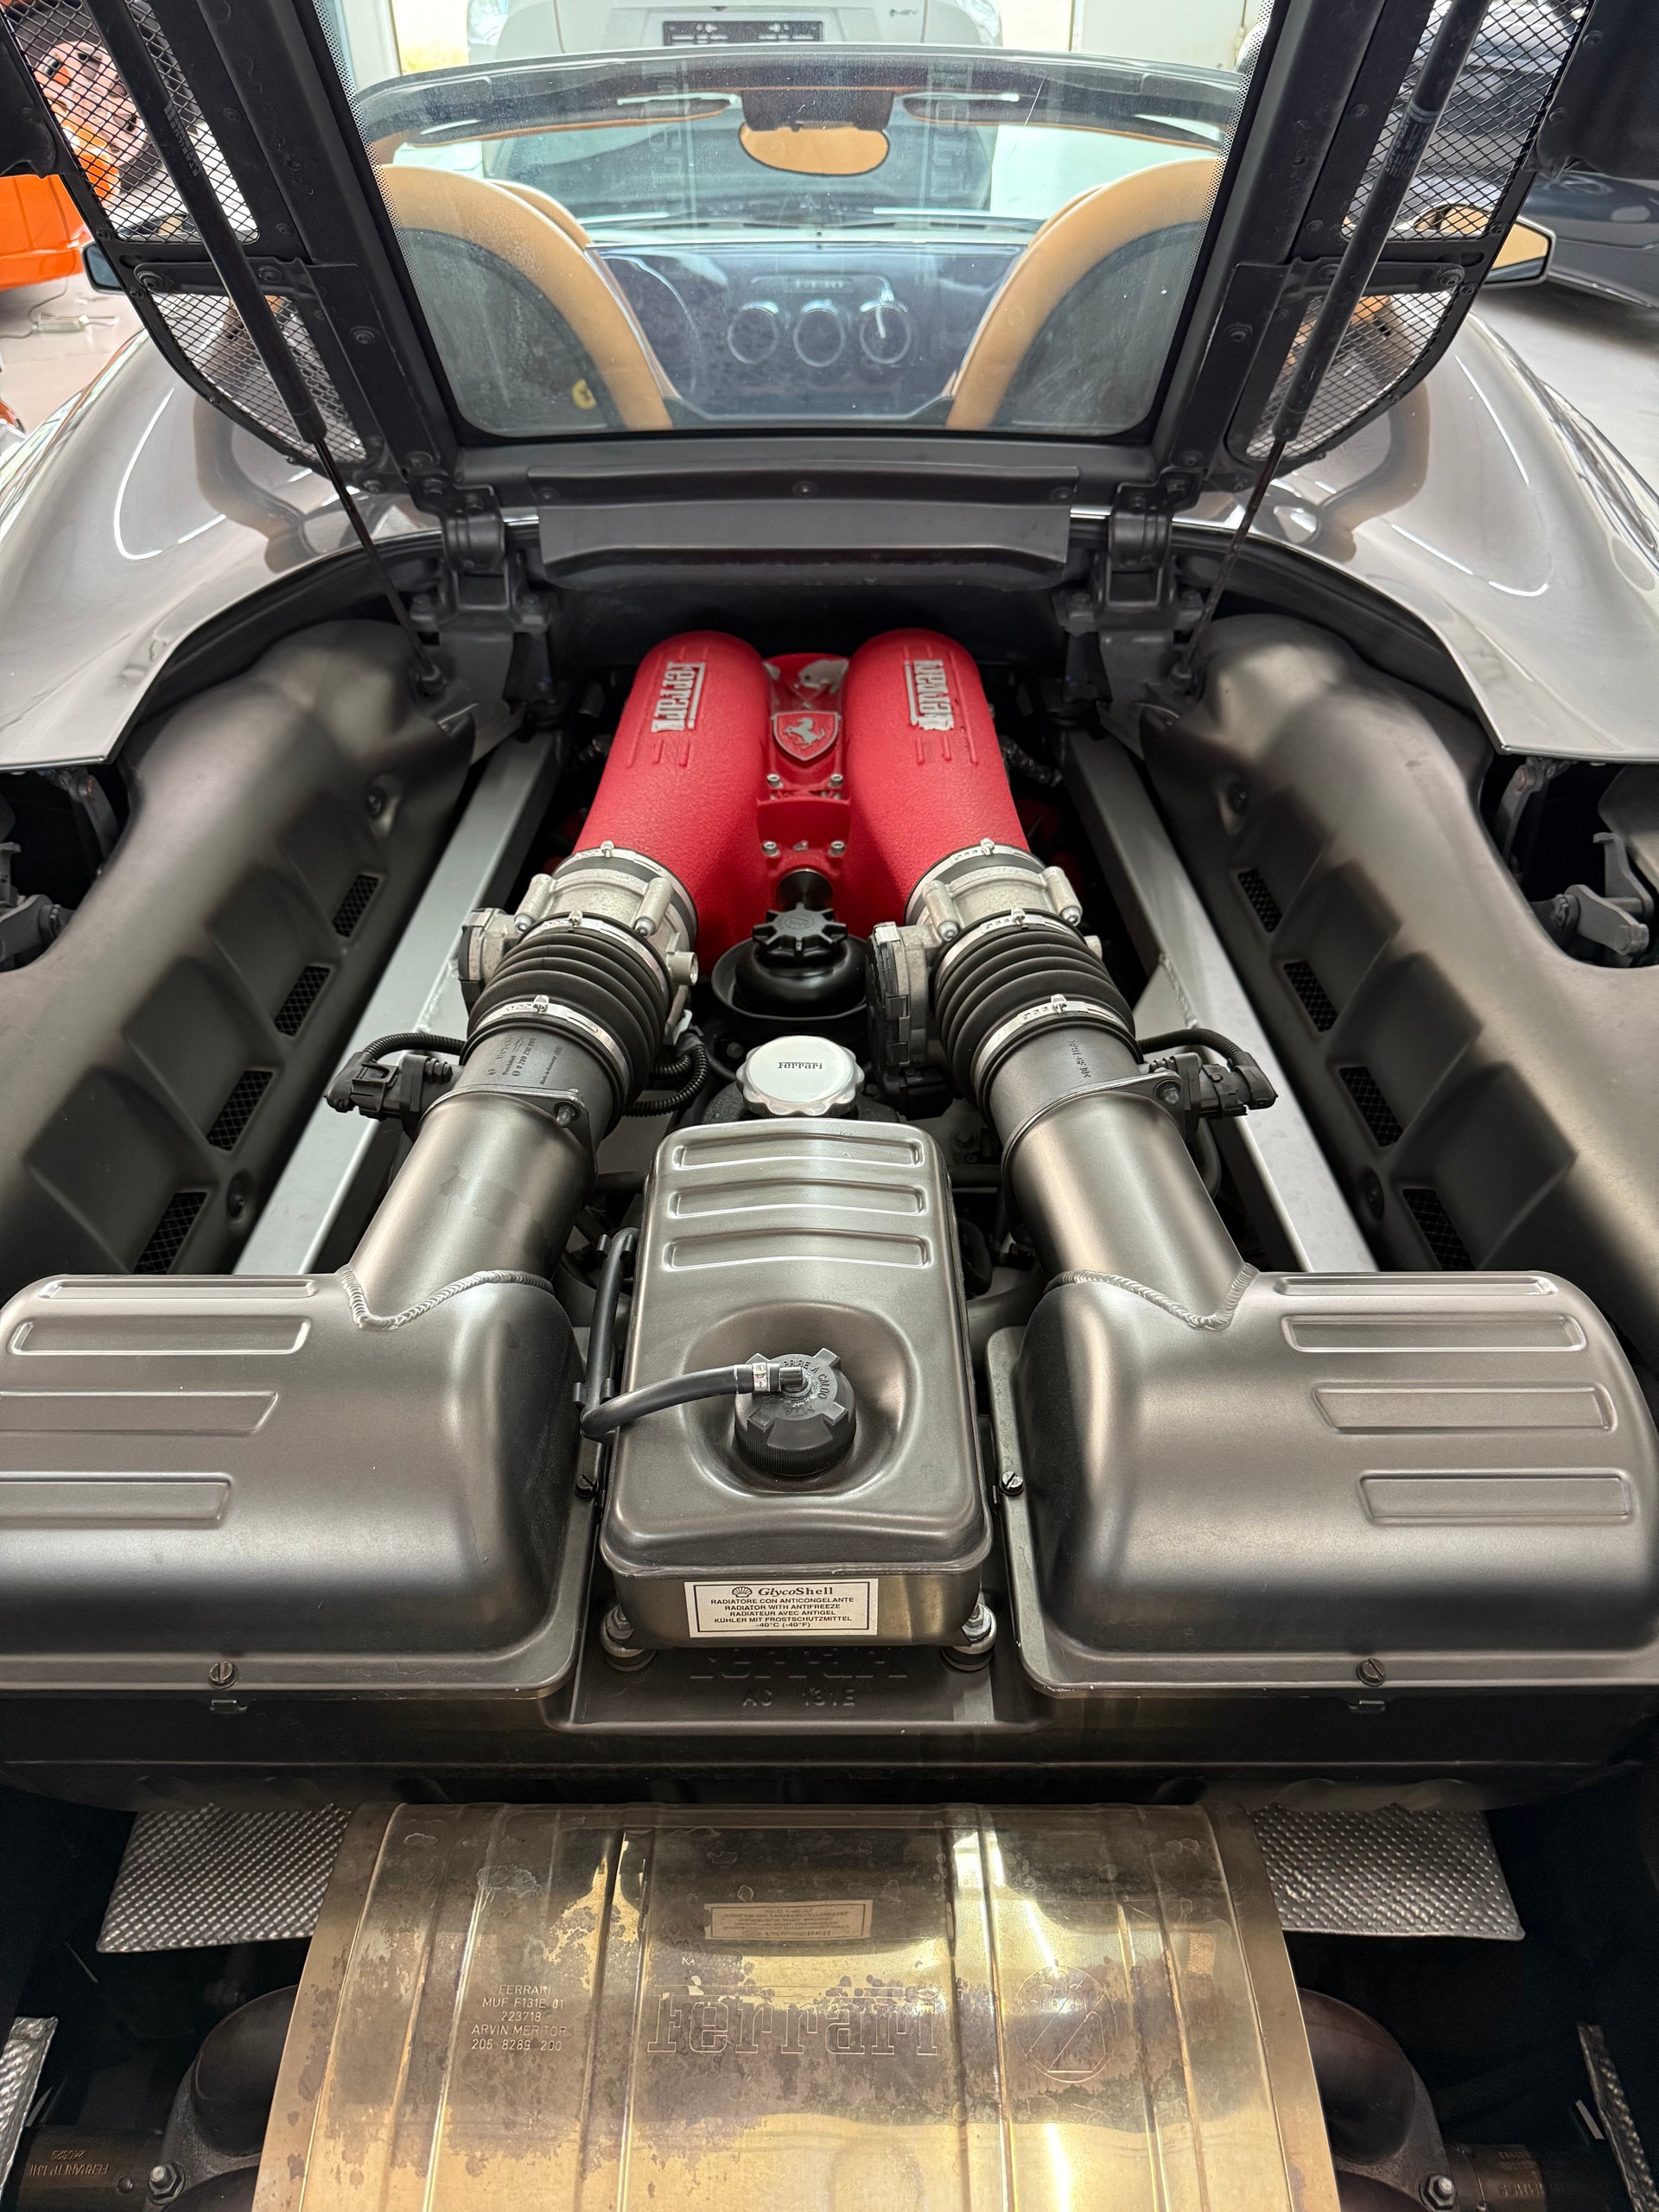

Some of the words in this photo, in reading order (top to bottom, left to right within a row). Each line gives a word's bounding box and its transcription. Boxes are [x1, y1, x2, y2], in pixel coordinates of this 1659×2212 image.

[651, 662, 705, 733] Ferrari
[778, 1061, 823, 1070] Ferrari
[817, 1373, 830, 1400] CALDO
[758, 1586, 834, 1598] GlycoShell
[742, 1688, 772, 1707] AC
[498, 1984, 551, 1995] FERRARI
[482, 1997, 510, 2007] MUF
[513, 1998, 548, 2009] F131E
[552, 1999, 564, 2009] 01
[500, 2011, 542, 2022] 223718
[647, 1985, 938, 2055] Ferrari
[471, 2024, 509, 2035] ARVIN
[512, 2025, 567, 2037] MERITOR
[471, 2038, 494, 2050] 205
[501, 2039, 531, 2050] 8289
[540, 2040, 563, 2051] 200
